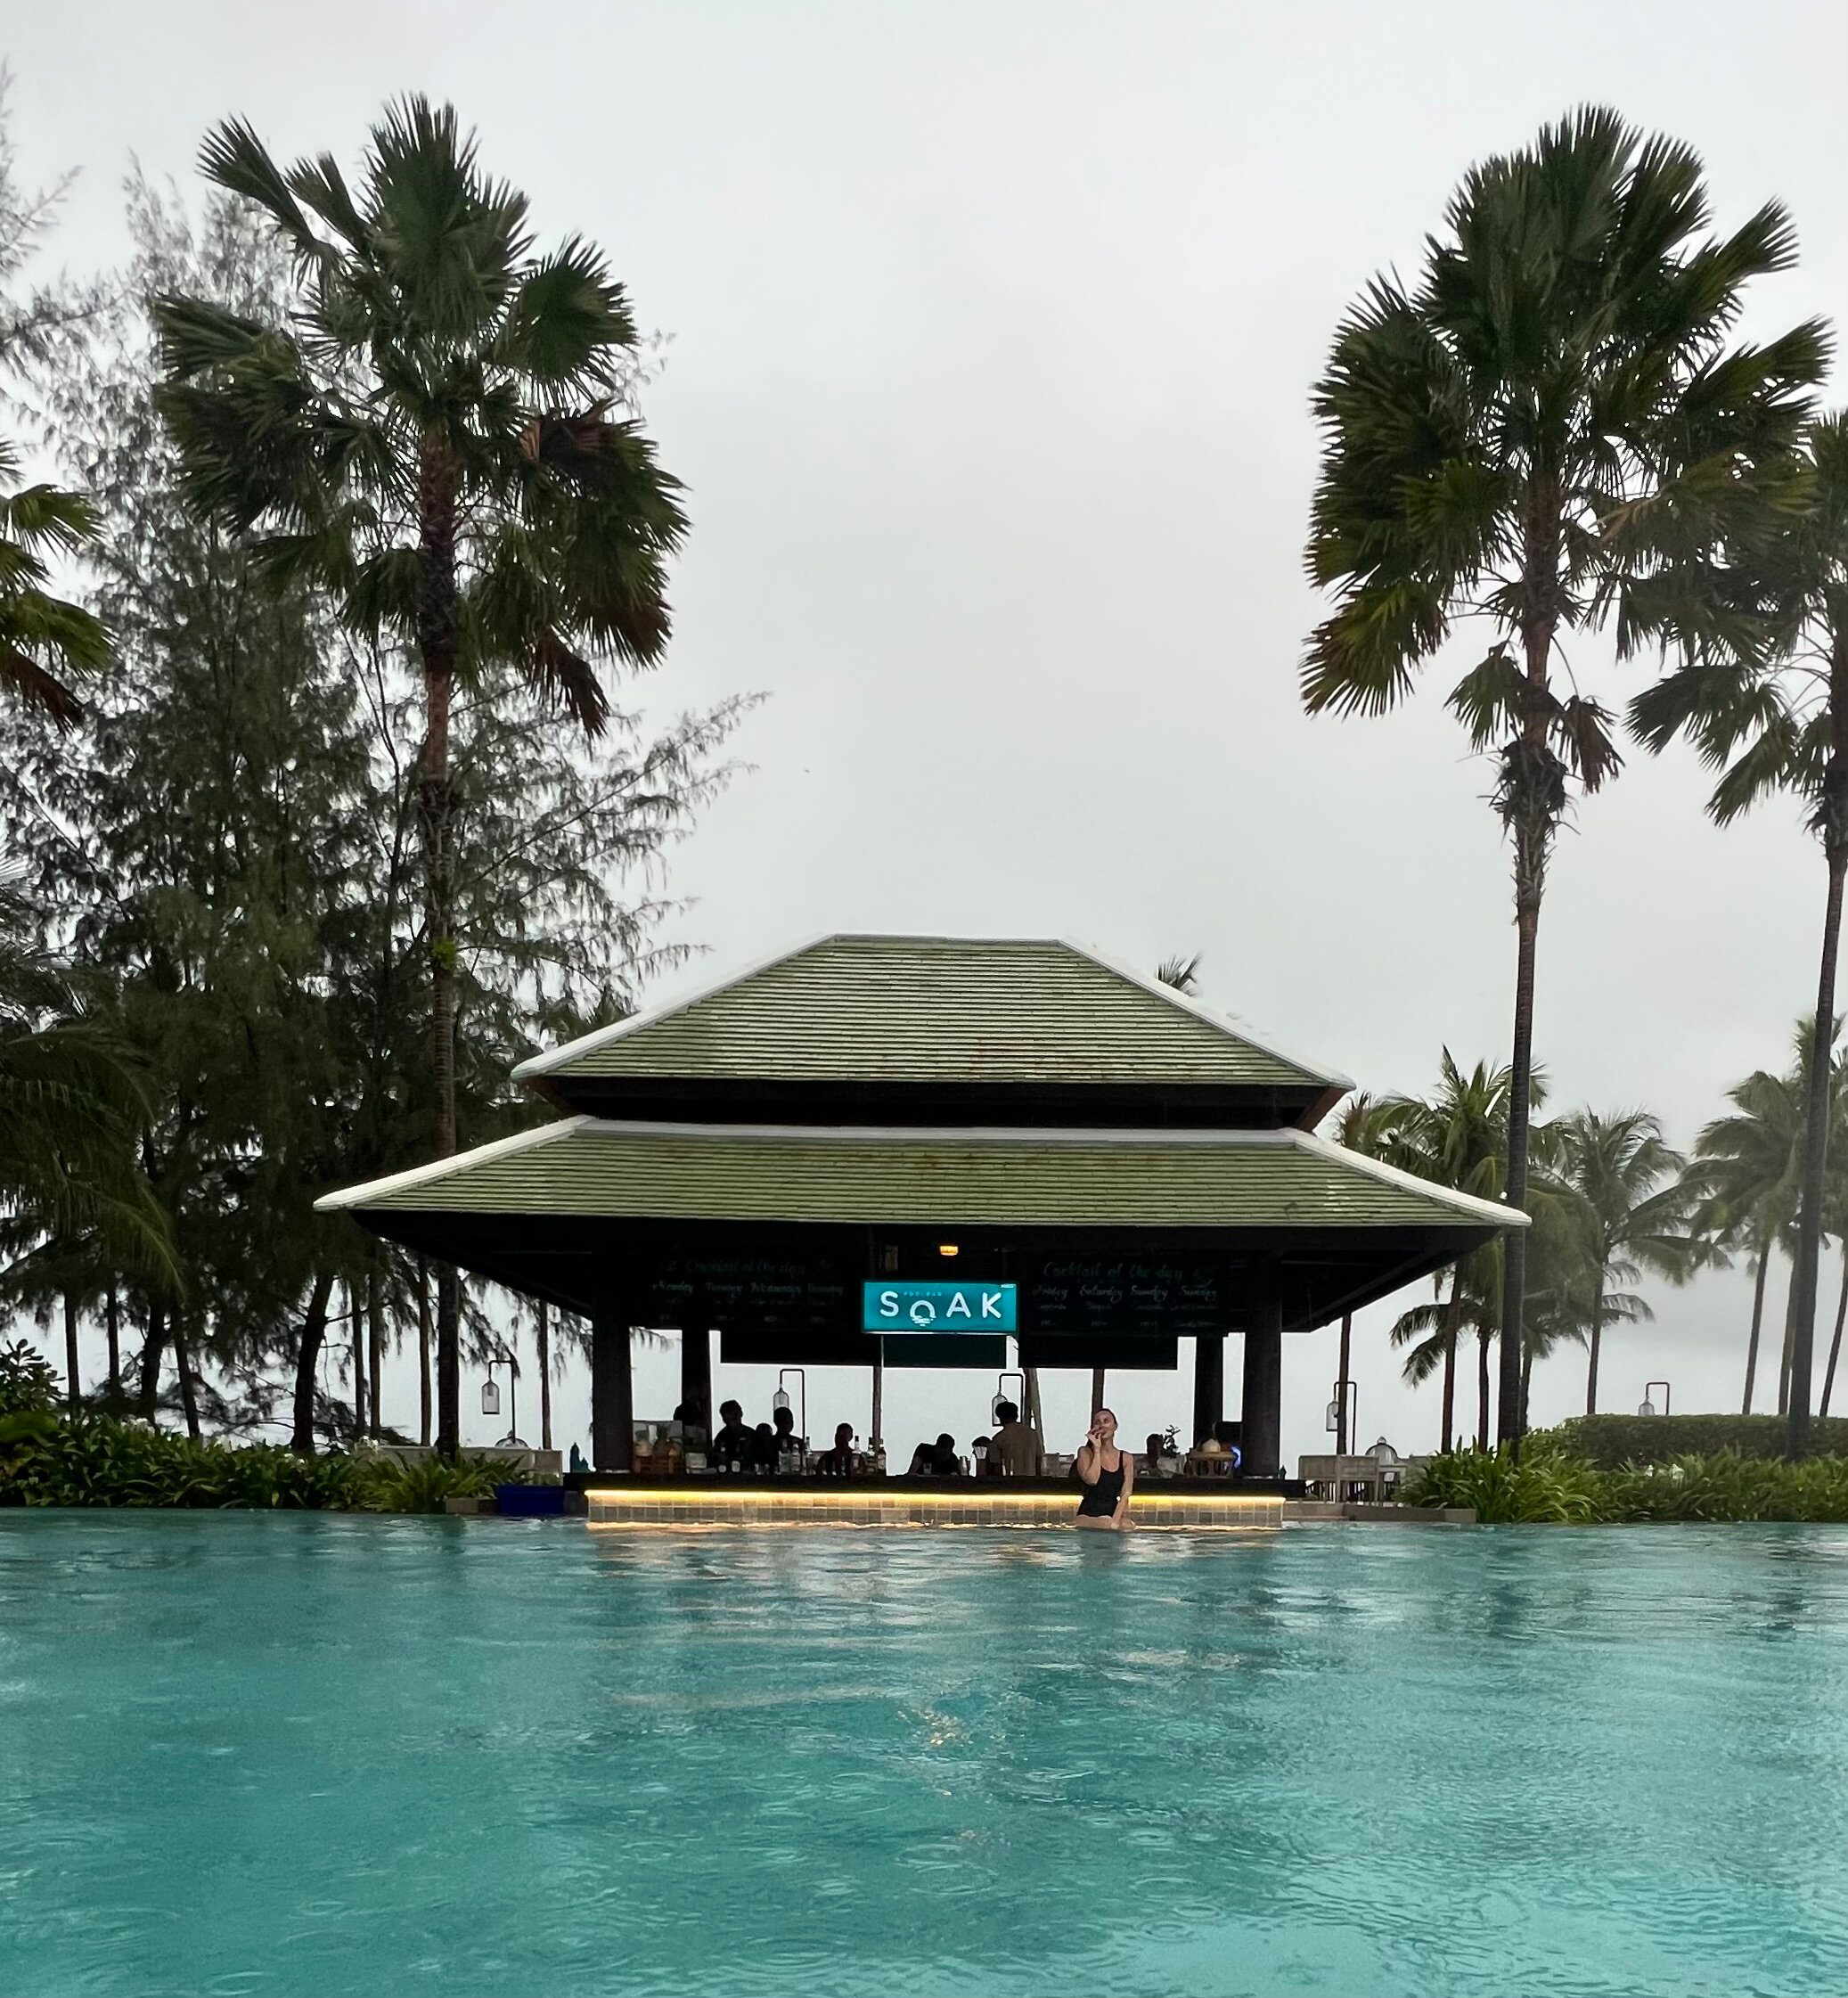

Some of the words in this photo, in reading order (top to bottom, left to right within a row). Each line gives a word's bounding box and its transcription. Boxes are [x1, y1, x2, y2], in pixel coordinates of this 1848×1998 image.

[1043, 1261, 1102, 1277] Cocktail
[1154, 1263, 1183, 1283] day
[879, 1290, 1002, 1327] SOAK
